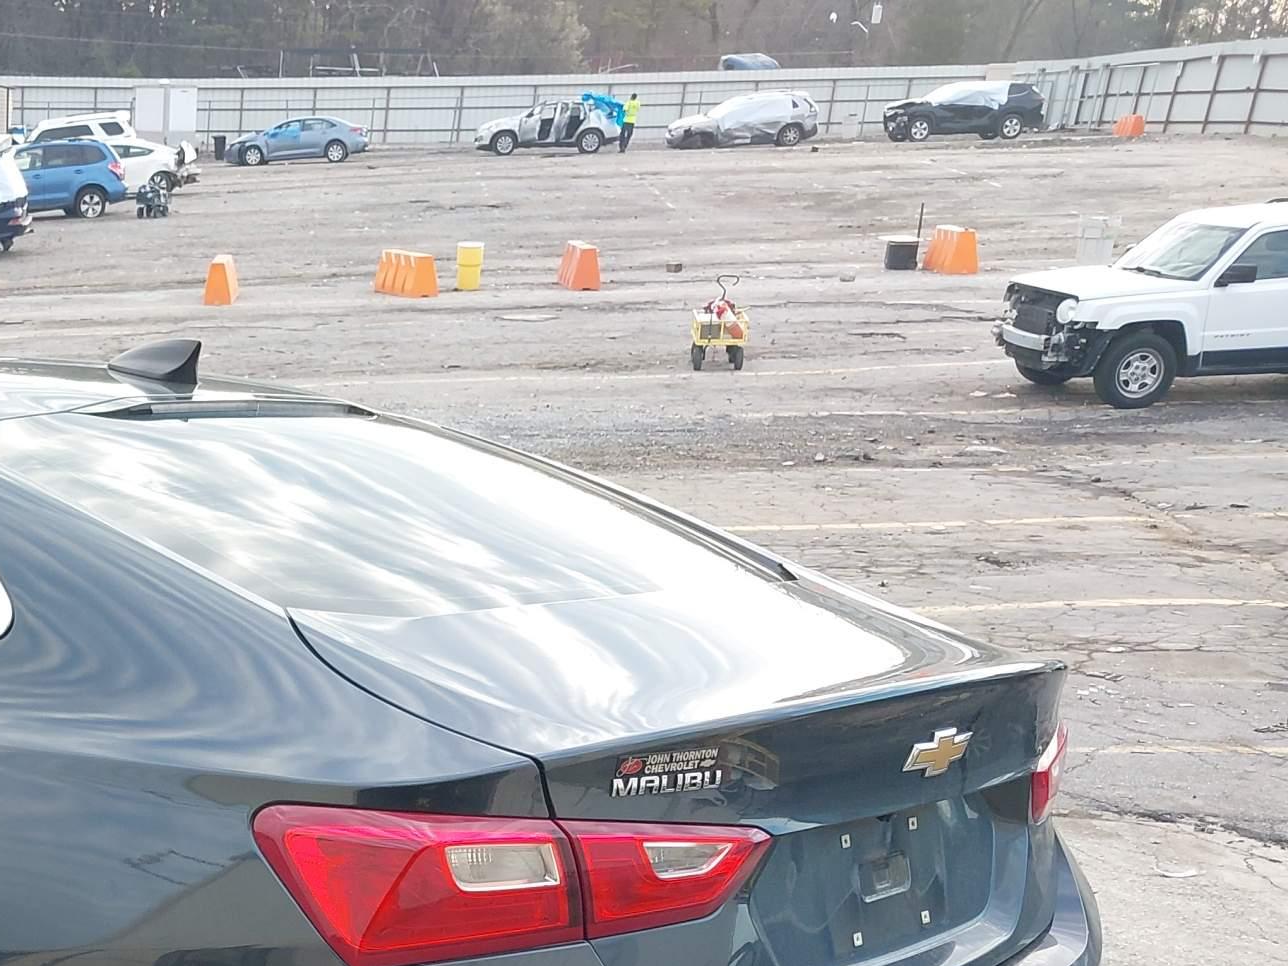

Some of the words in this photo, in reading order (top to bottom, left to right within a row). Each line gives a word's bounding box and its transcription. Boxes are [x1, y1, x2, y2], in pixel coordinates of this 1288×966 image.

[646, 753, 671, 765] JOHN
[672, 748, 719, 763] THORNTON
[644, 760, 700, 775] CHEVROLET
[611, 770, 722, 798] MALIBU
